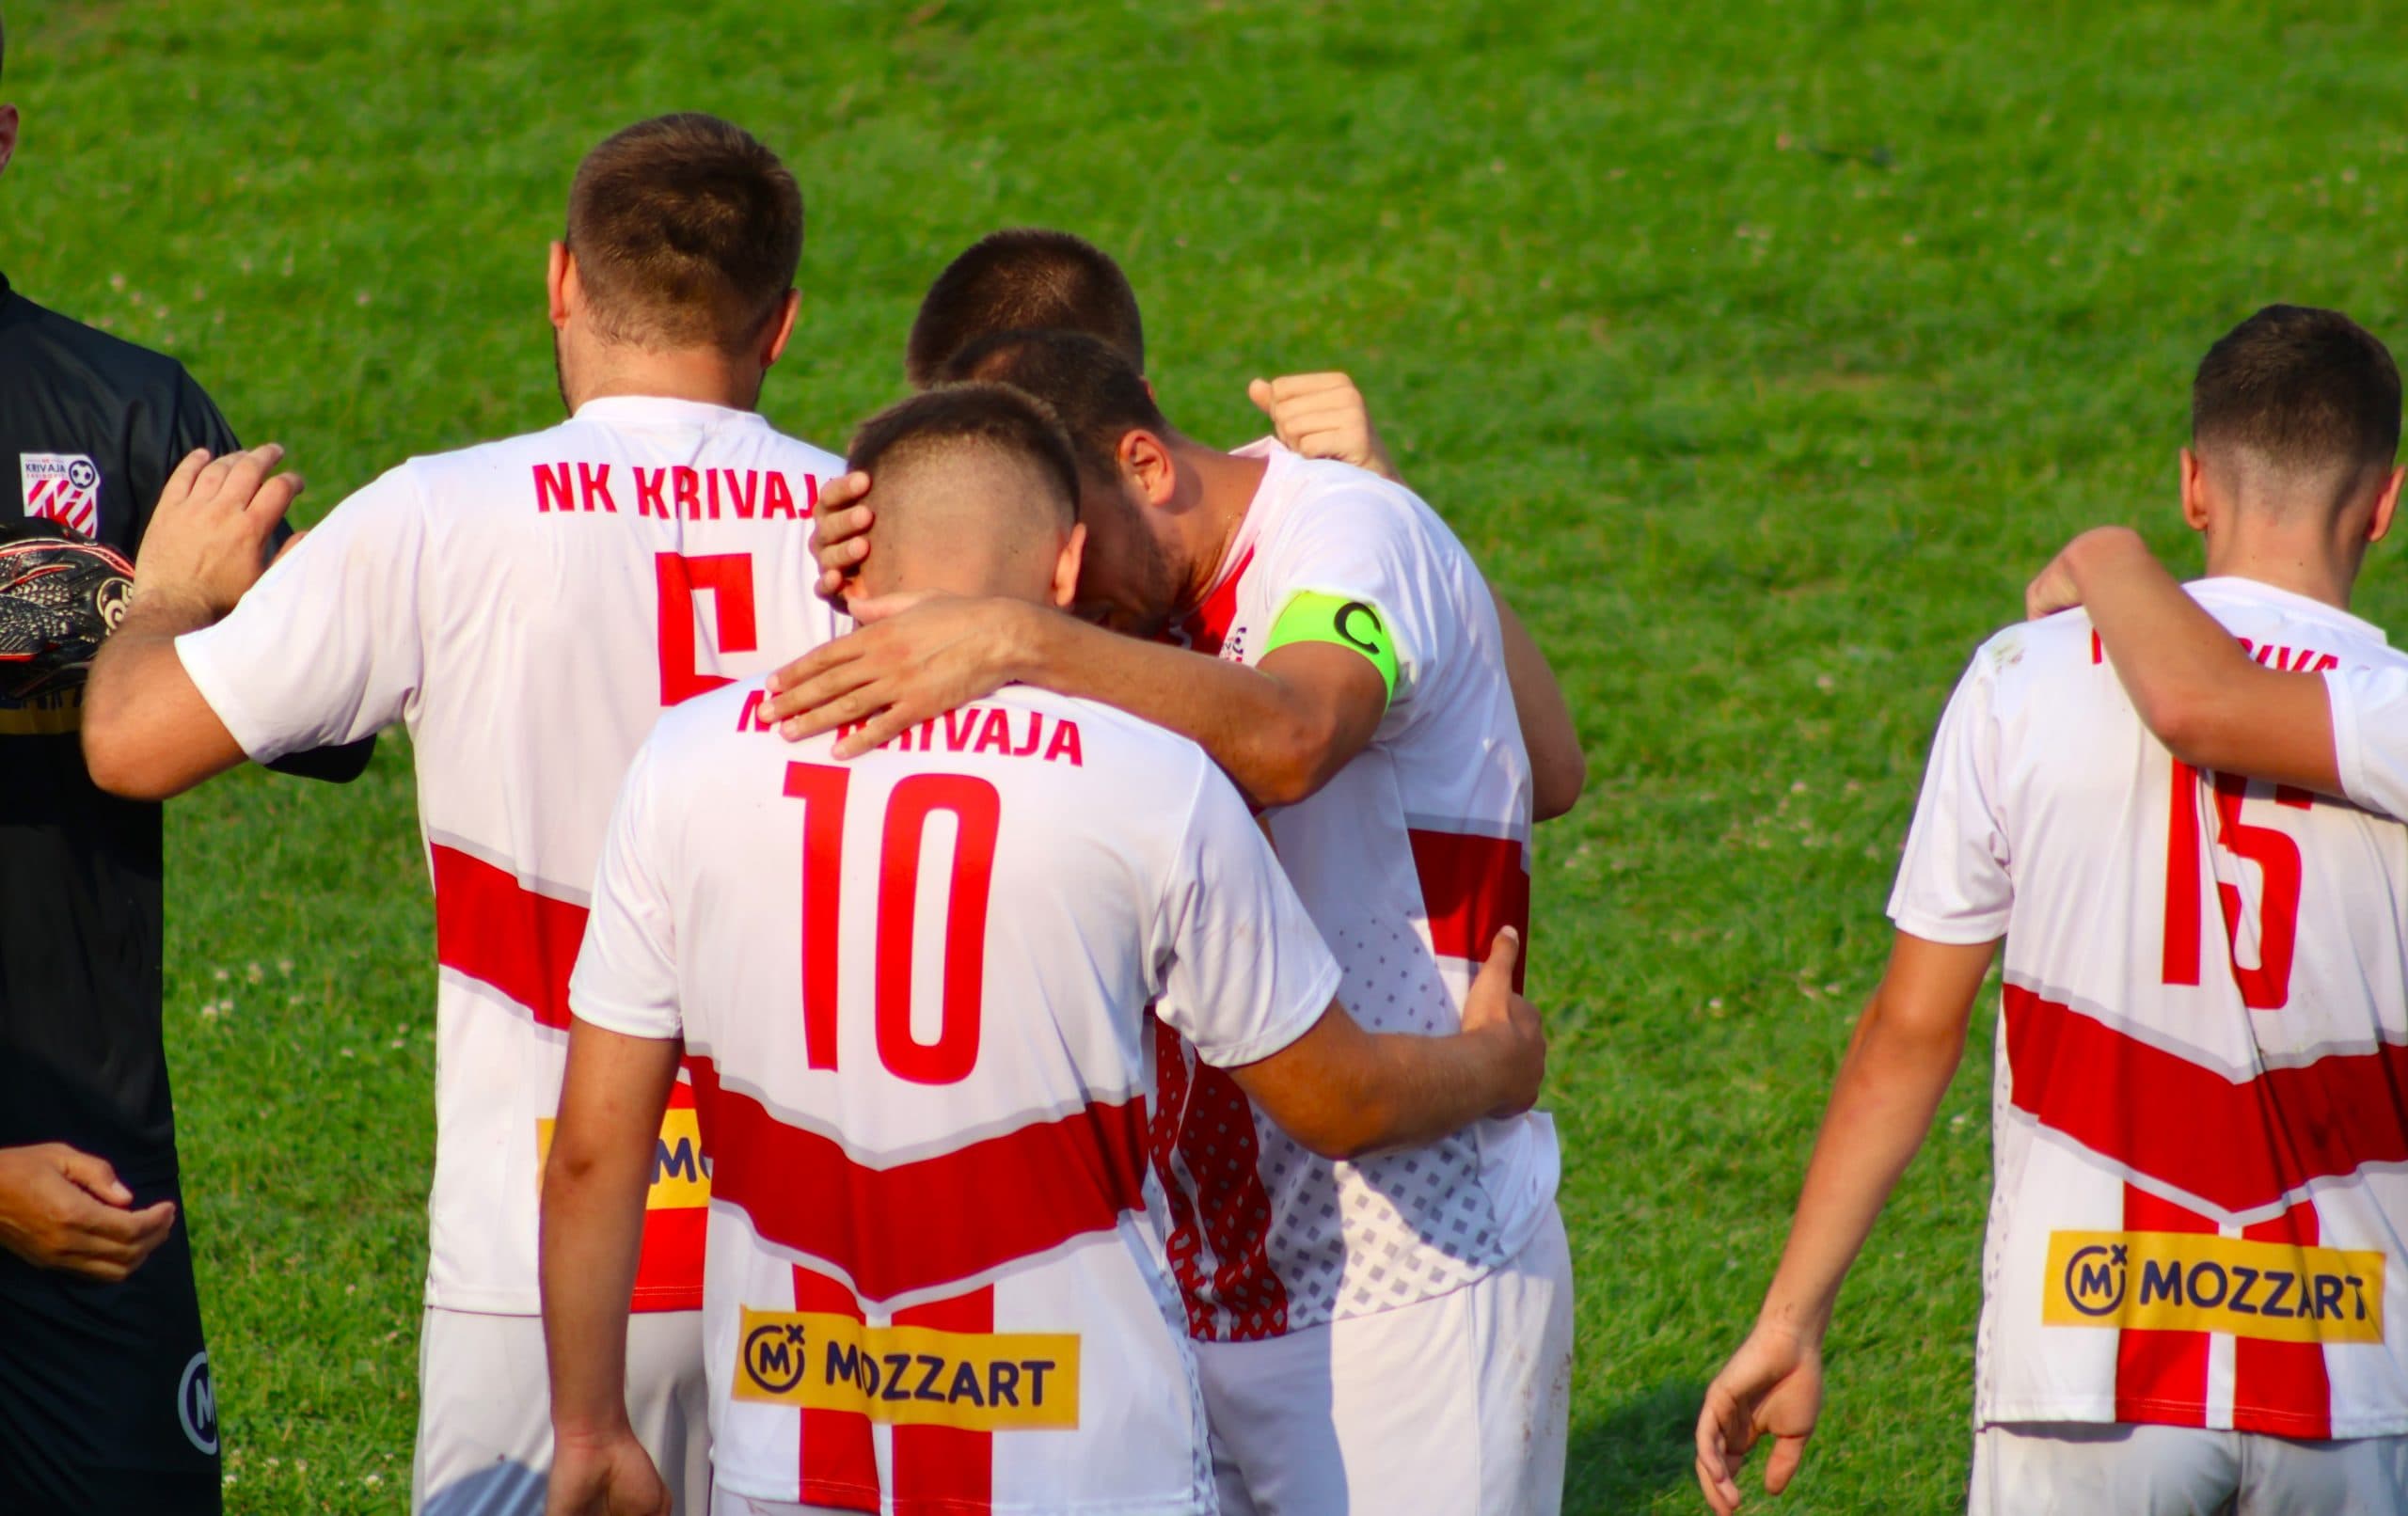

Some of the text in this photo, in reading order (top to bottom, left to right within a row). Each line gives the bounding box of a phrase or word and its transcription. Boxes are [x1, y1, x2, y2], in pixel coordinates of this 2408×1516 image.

[532, 463, 818, 520] NK KRIVAJ
[1334, 602, 1382, 655] C
[2162, 755, 2315, 1010] 15
[783, 761, 1000, 1085] 10
[2140, 1260, 2366, 1320] MOZZART
[825, 1341, 1055, 1407] MOZZART
